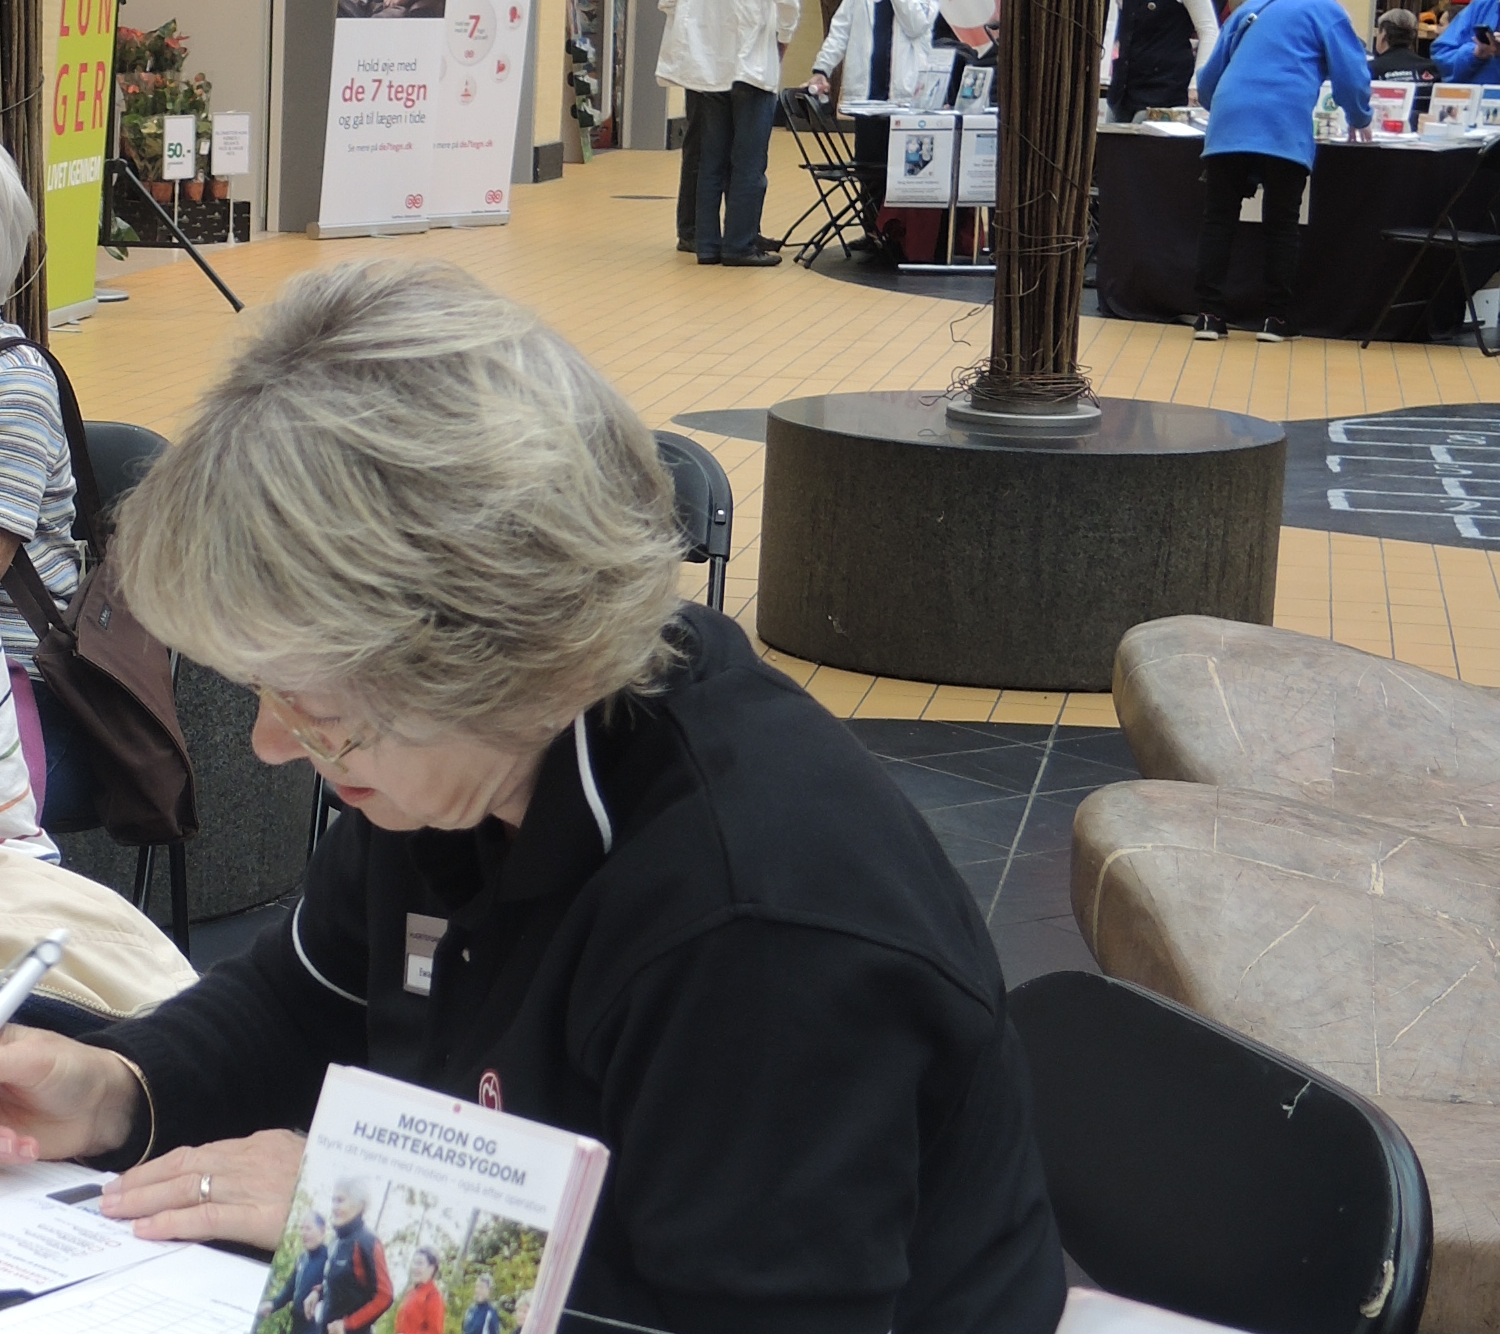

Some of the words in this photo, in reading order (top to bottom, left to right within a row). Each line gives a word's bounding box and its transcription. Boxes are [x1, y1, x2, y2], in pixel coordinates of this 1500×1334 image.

[357, 59, 378, 72] Hold
[381, 62, 395, 75] øje
[397, 59, 417, 72] med
[342, 78, 365, 102] de
[371, 79, 383, 102] 7
[387, 80, 427, 109] tegn
[338, 115, 351, 130] og
[353, 113, 363, 129] gå
[366, 111, 374, 125] til
[376, 111, 403, 128] lægen
[409, 111, 426, 124] tide
[47, 159, 66, 191] LIVET
[67, 154, 101, 187] IGENNEM
[353, 1121, 527, 1186] HJERTEKARSYGDOM
[398, 1114, 470, 1147] MOTION
[473, 1135, 498, 1156] OG
[317, 1134, 343, 1153] Styrk
[345, 1140, 359, 1155] dit
[361, 1144, 388, 1163] hjerte
[390, 1154, 413, 1172] med
[415, 1161, 448, 1183] motion
[458, 1178, 480, 1196] også
[481, 1182, 504, 1200] efter
[505, 1190, 547, 1214] operation
